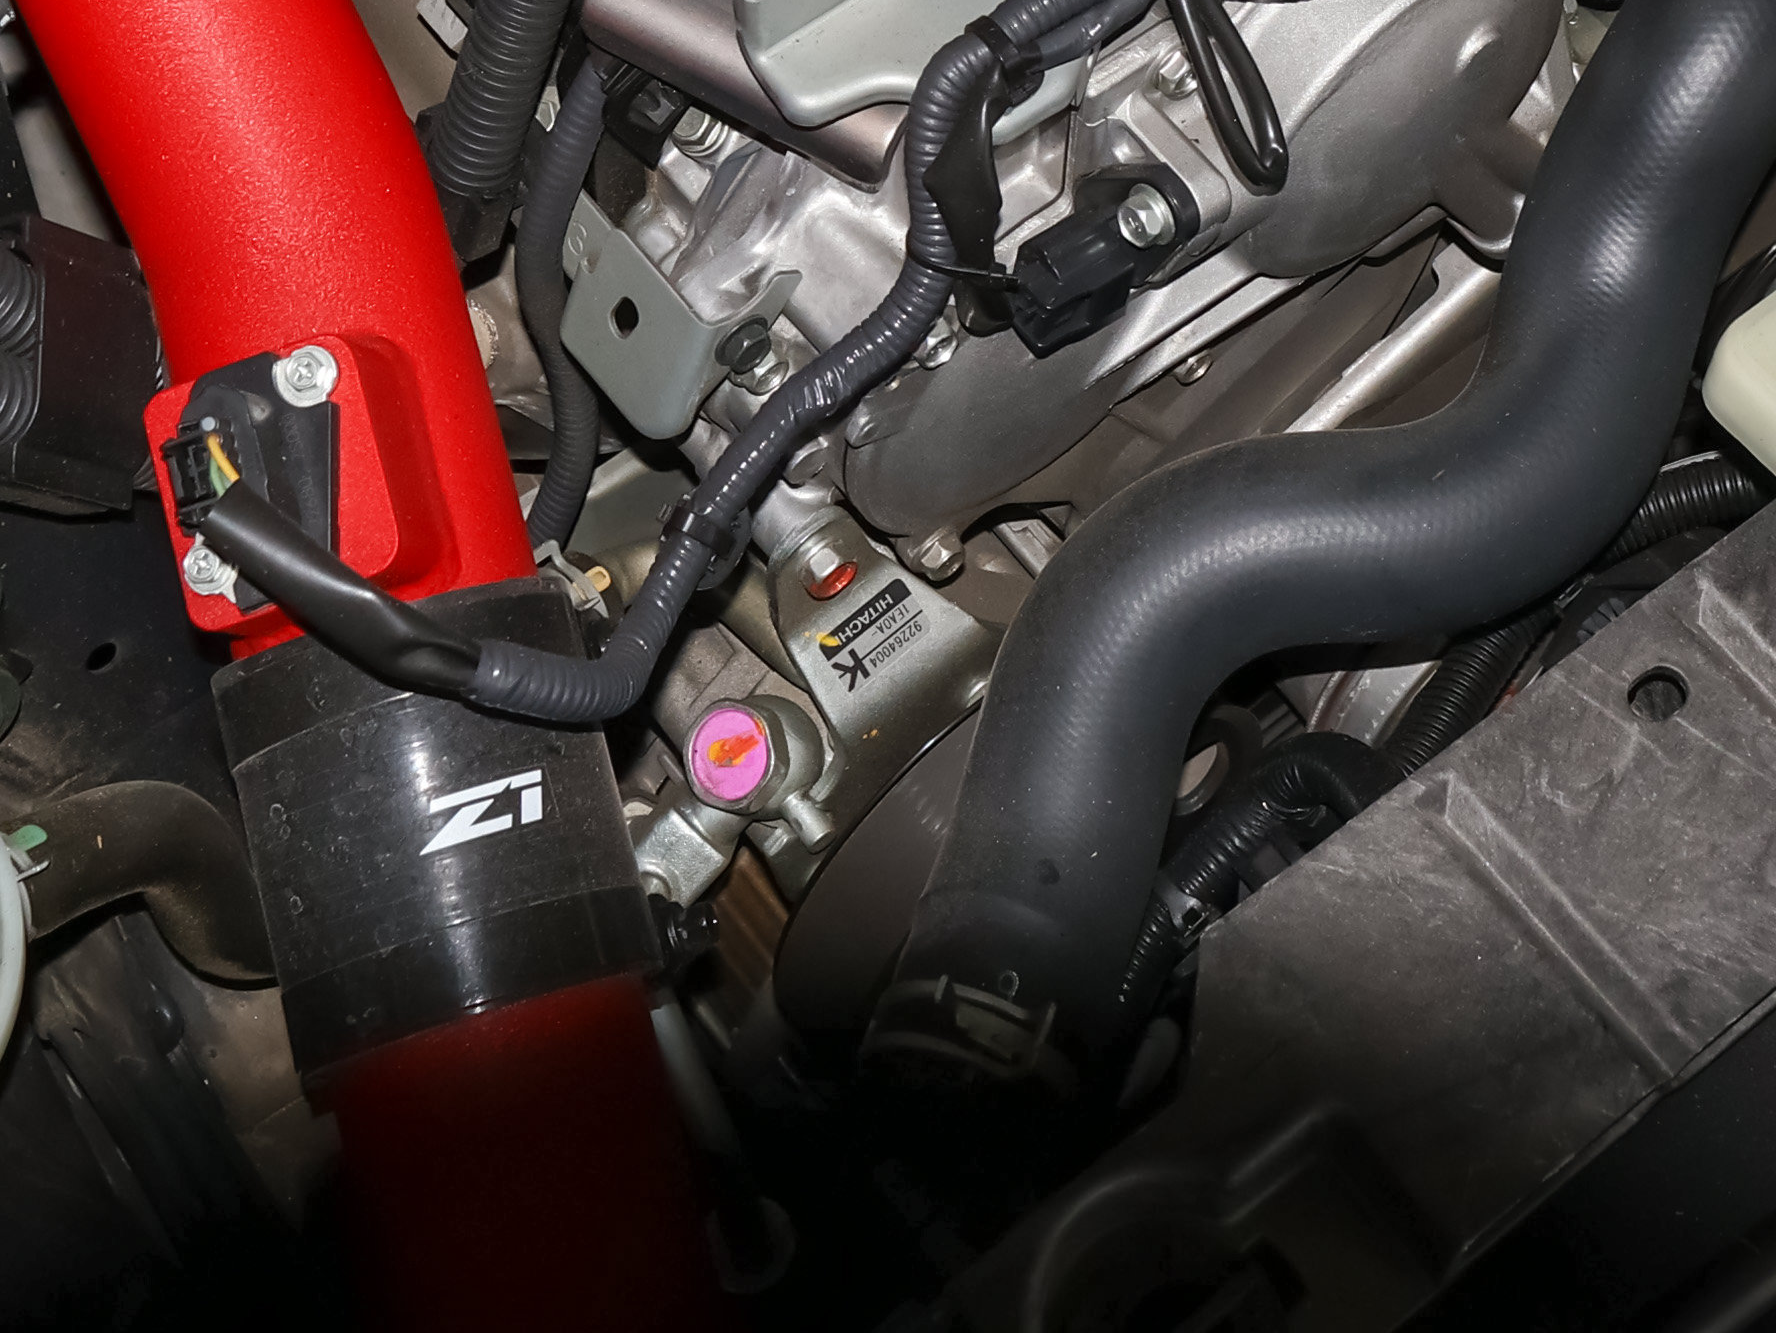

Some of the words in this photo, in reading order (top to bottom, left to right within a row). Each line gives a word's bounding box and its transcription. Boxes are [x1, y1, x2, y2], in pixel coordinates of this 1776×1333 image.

[835, 593, 894, 646] HITACHI
[869, 620, 923, 669] 92264004
[831, 648, 871, 693] K
